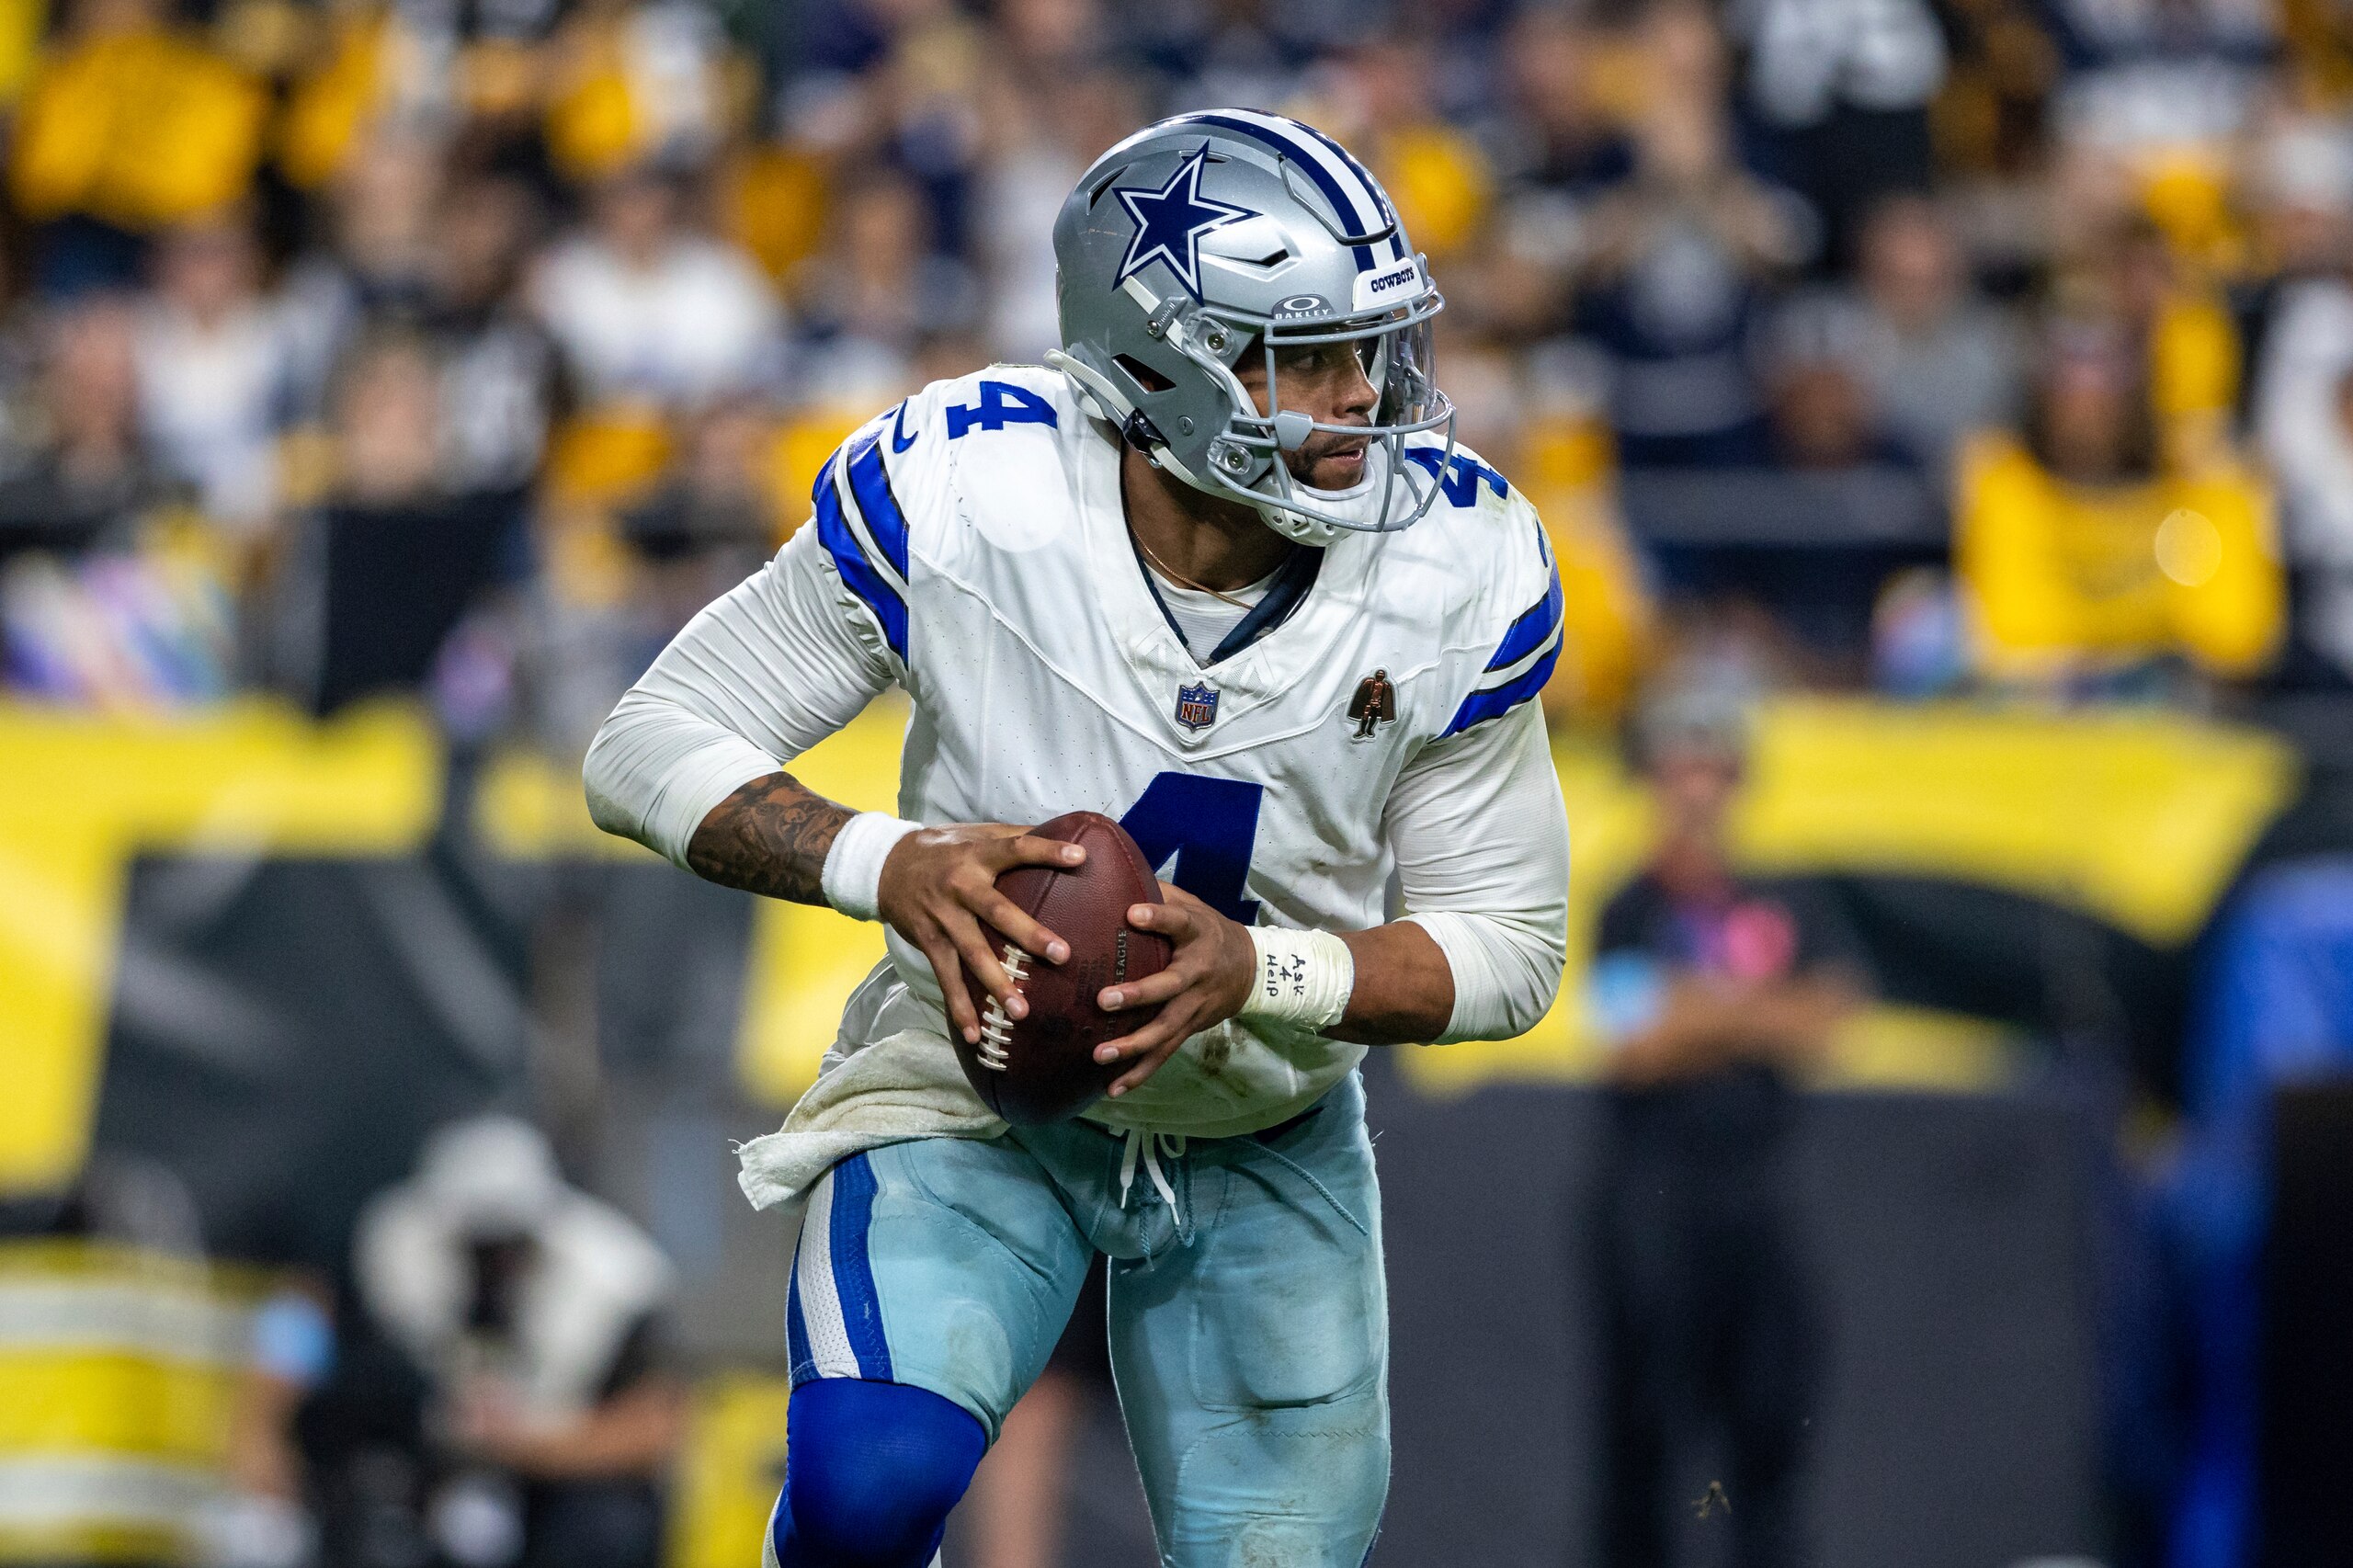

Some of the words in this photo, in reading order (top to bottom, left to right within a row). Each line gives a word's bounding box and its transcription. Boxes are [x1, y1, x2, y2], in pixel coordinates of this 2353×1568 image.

[1370, 267, 1415, 293] COWBOYS
[1275, 308, 1330, 320] OAKLEY
[945, 381, 1058, 440] 4
[1404, 447, 1509, 507] 4
[1181, 703, 1210, 723] NFL
[1119, 771, 1265, 926] 4
[1114, 929, 1128, 986] LEAGUE
[1279, 965, 1293, 982] 4
